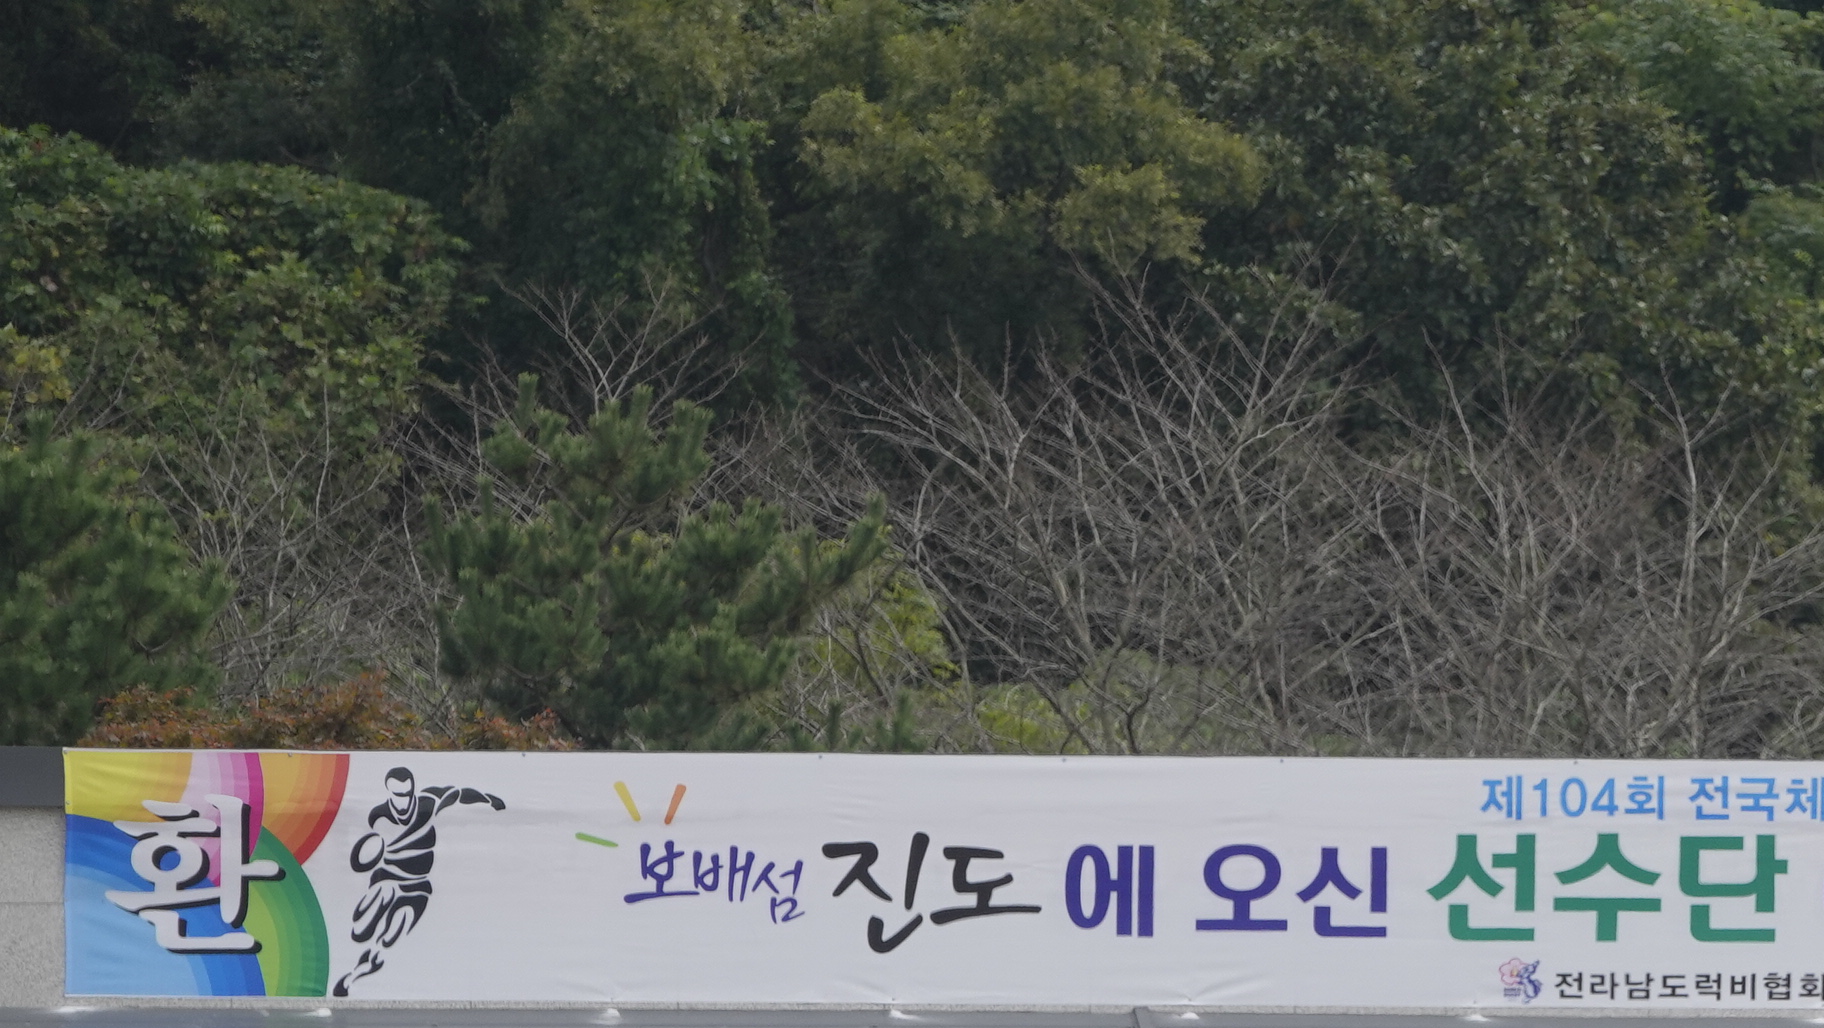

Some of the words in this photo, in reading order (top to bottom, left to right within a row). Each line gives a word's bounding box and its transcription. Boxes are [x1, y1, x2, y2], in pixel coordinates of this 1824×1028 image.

[1482, 775, 1663, 821] 제104회
[105, 794, 286, 954] 환
[624, 840, 804, 923] 보배섬
[822, 832, 1042, 953] 진도
[1196, 844, 1387, 937] 오신
[1427, 833, 1788, 942] 선수단
